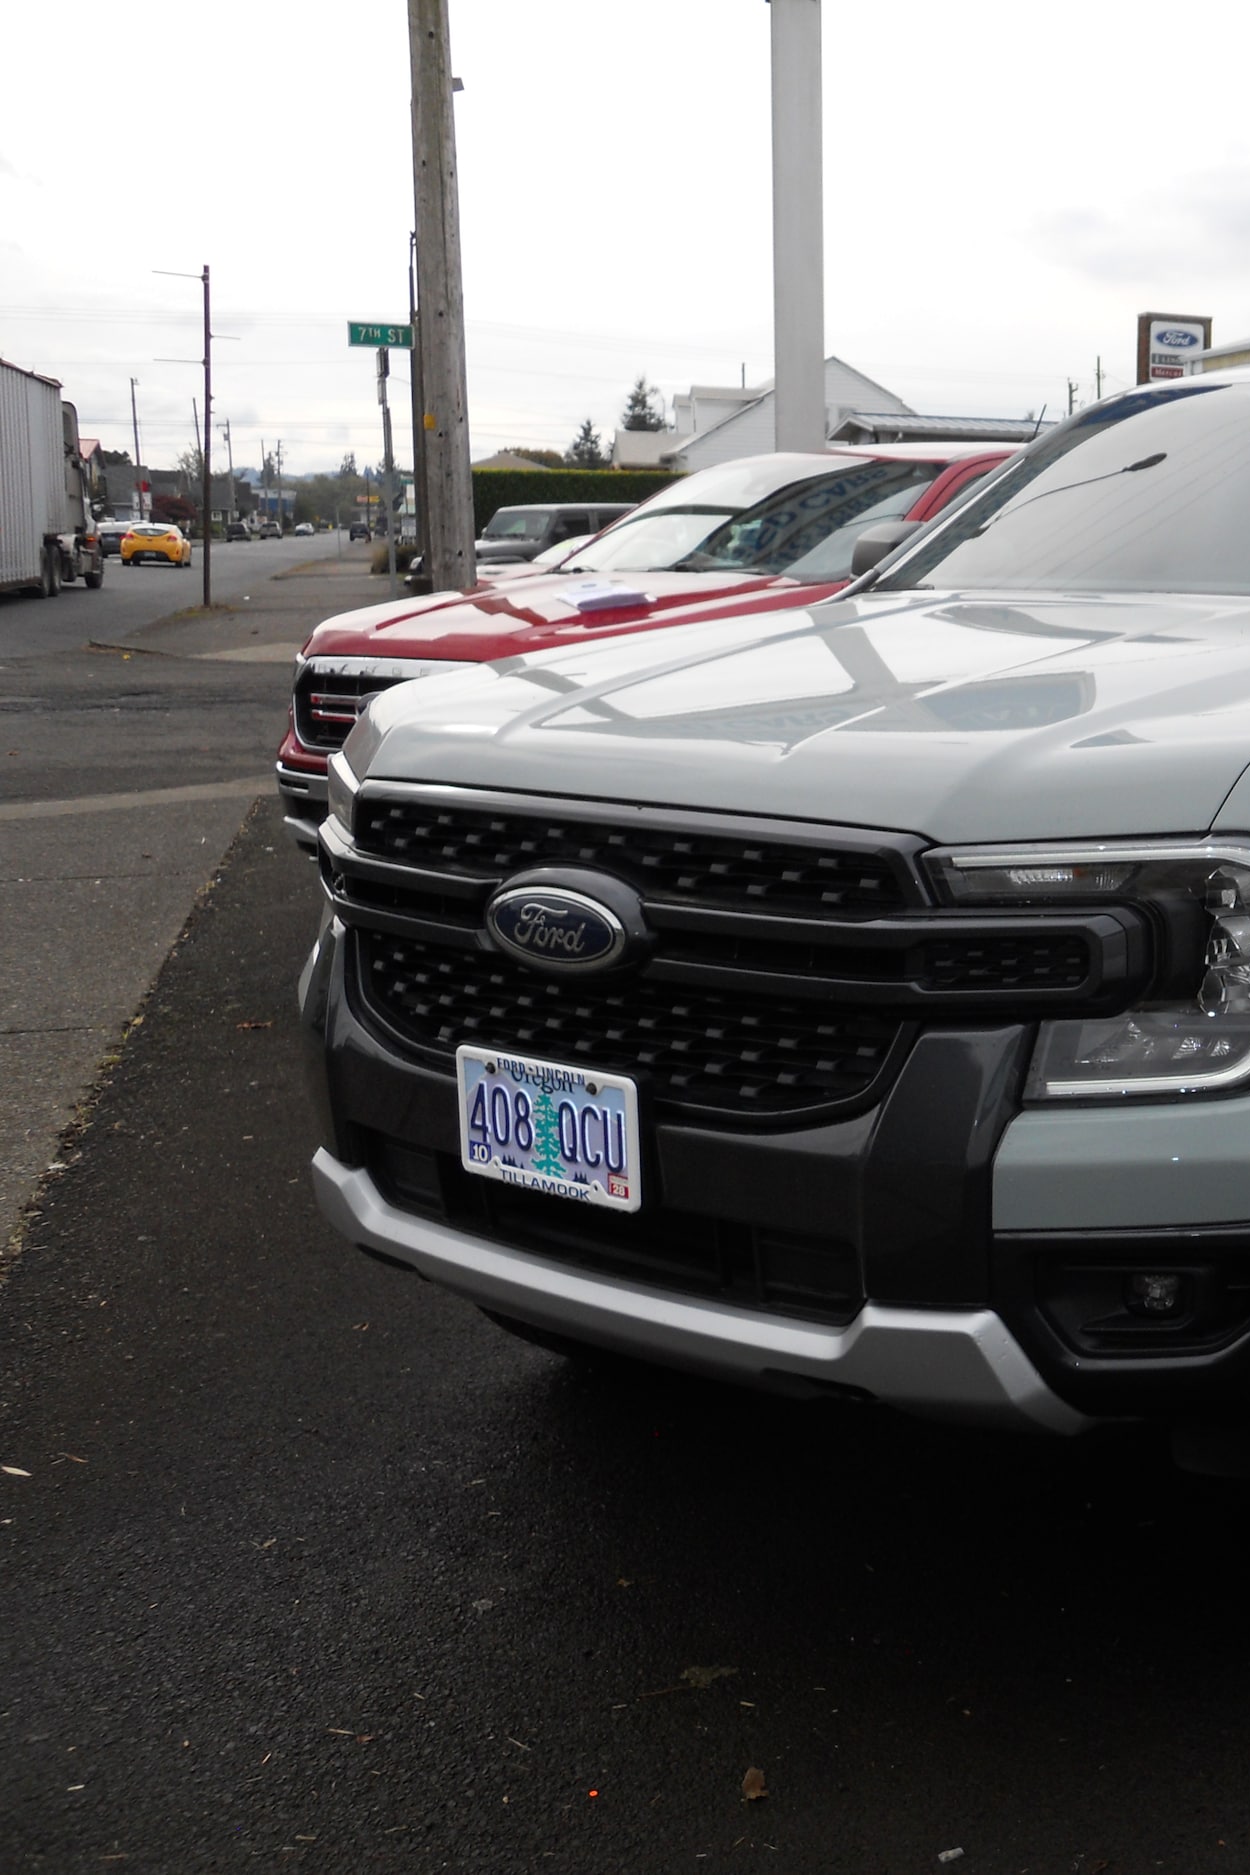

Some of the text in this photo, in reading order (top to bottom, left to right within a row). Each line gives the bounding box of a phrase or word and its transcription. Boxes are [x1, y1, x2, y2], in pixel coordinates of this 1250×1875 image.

[358, 326, 404, 344] 7TH ST
[1162, 331, 1191, 346] Ford
[514, 902, 587, 953] Ford
[496, 1057, 586, 1086] FORD LINCOLN
[470, 1082, 626, 1173] 408 QCU
[472, 1143, 489, 1162] 10
[499, 1168, 591, 1201] TILLAMOOK
